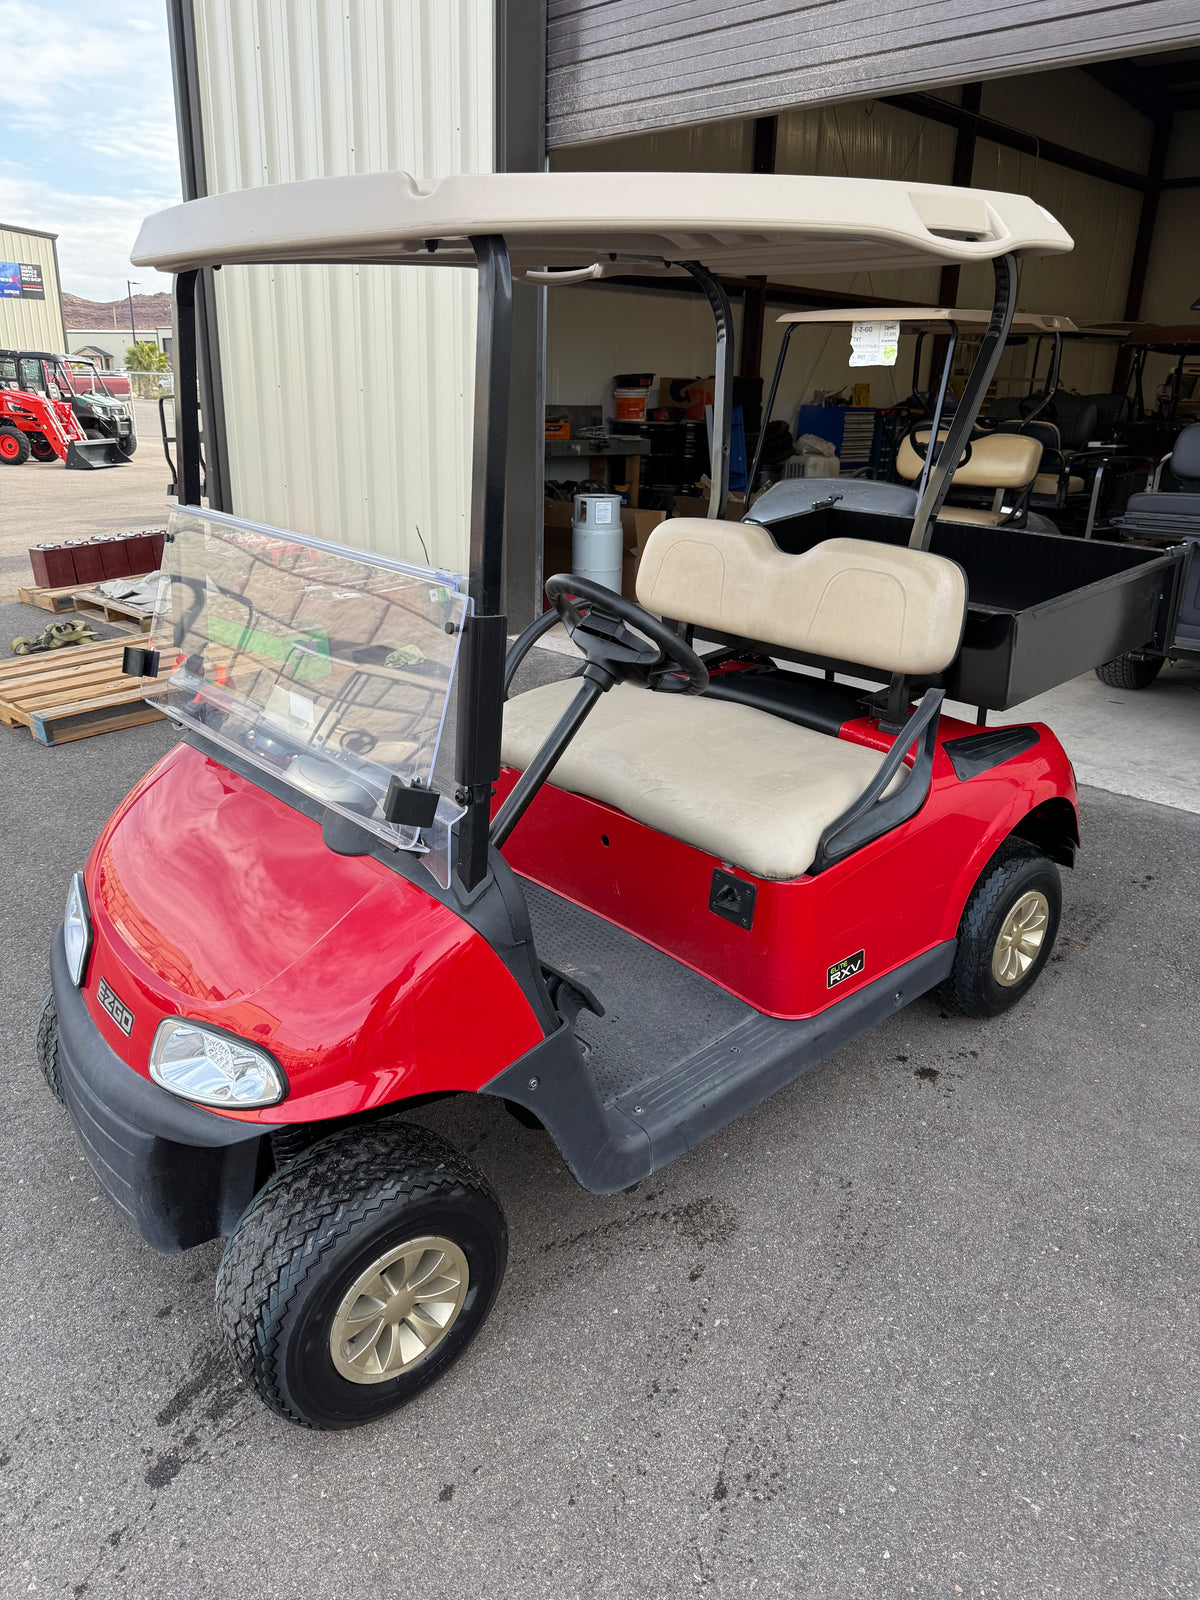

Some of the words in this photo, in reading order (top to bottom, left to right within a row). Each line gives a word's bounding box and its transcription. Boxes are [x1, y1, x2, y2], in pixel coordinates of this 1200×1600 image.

[830, 960, 848, 975] ELITE
[830, 959, 861, 985] RXV
[97, 978, 133, 1034] EZGO
